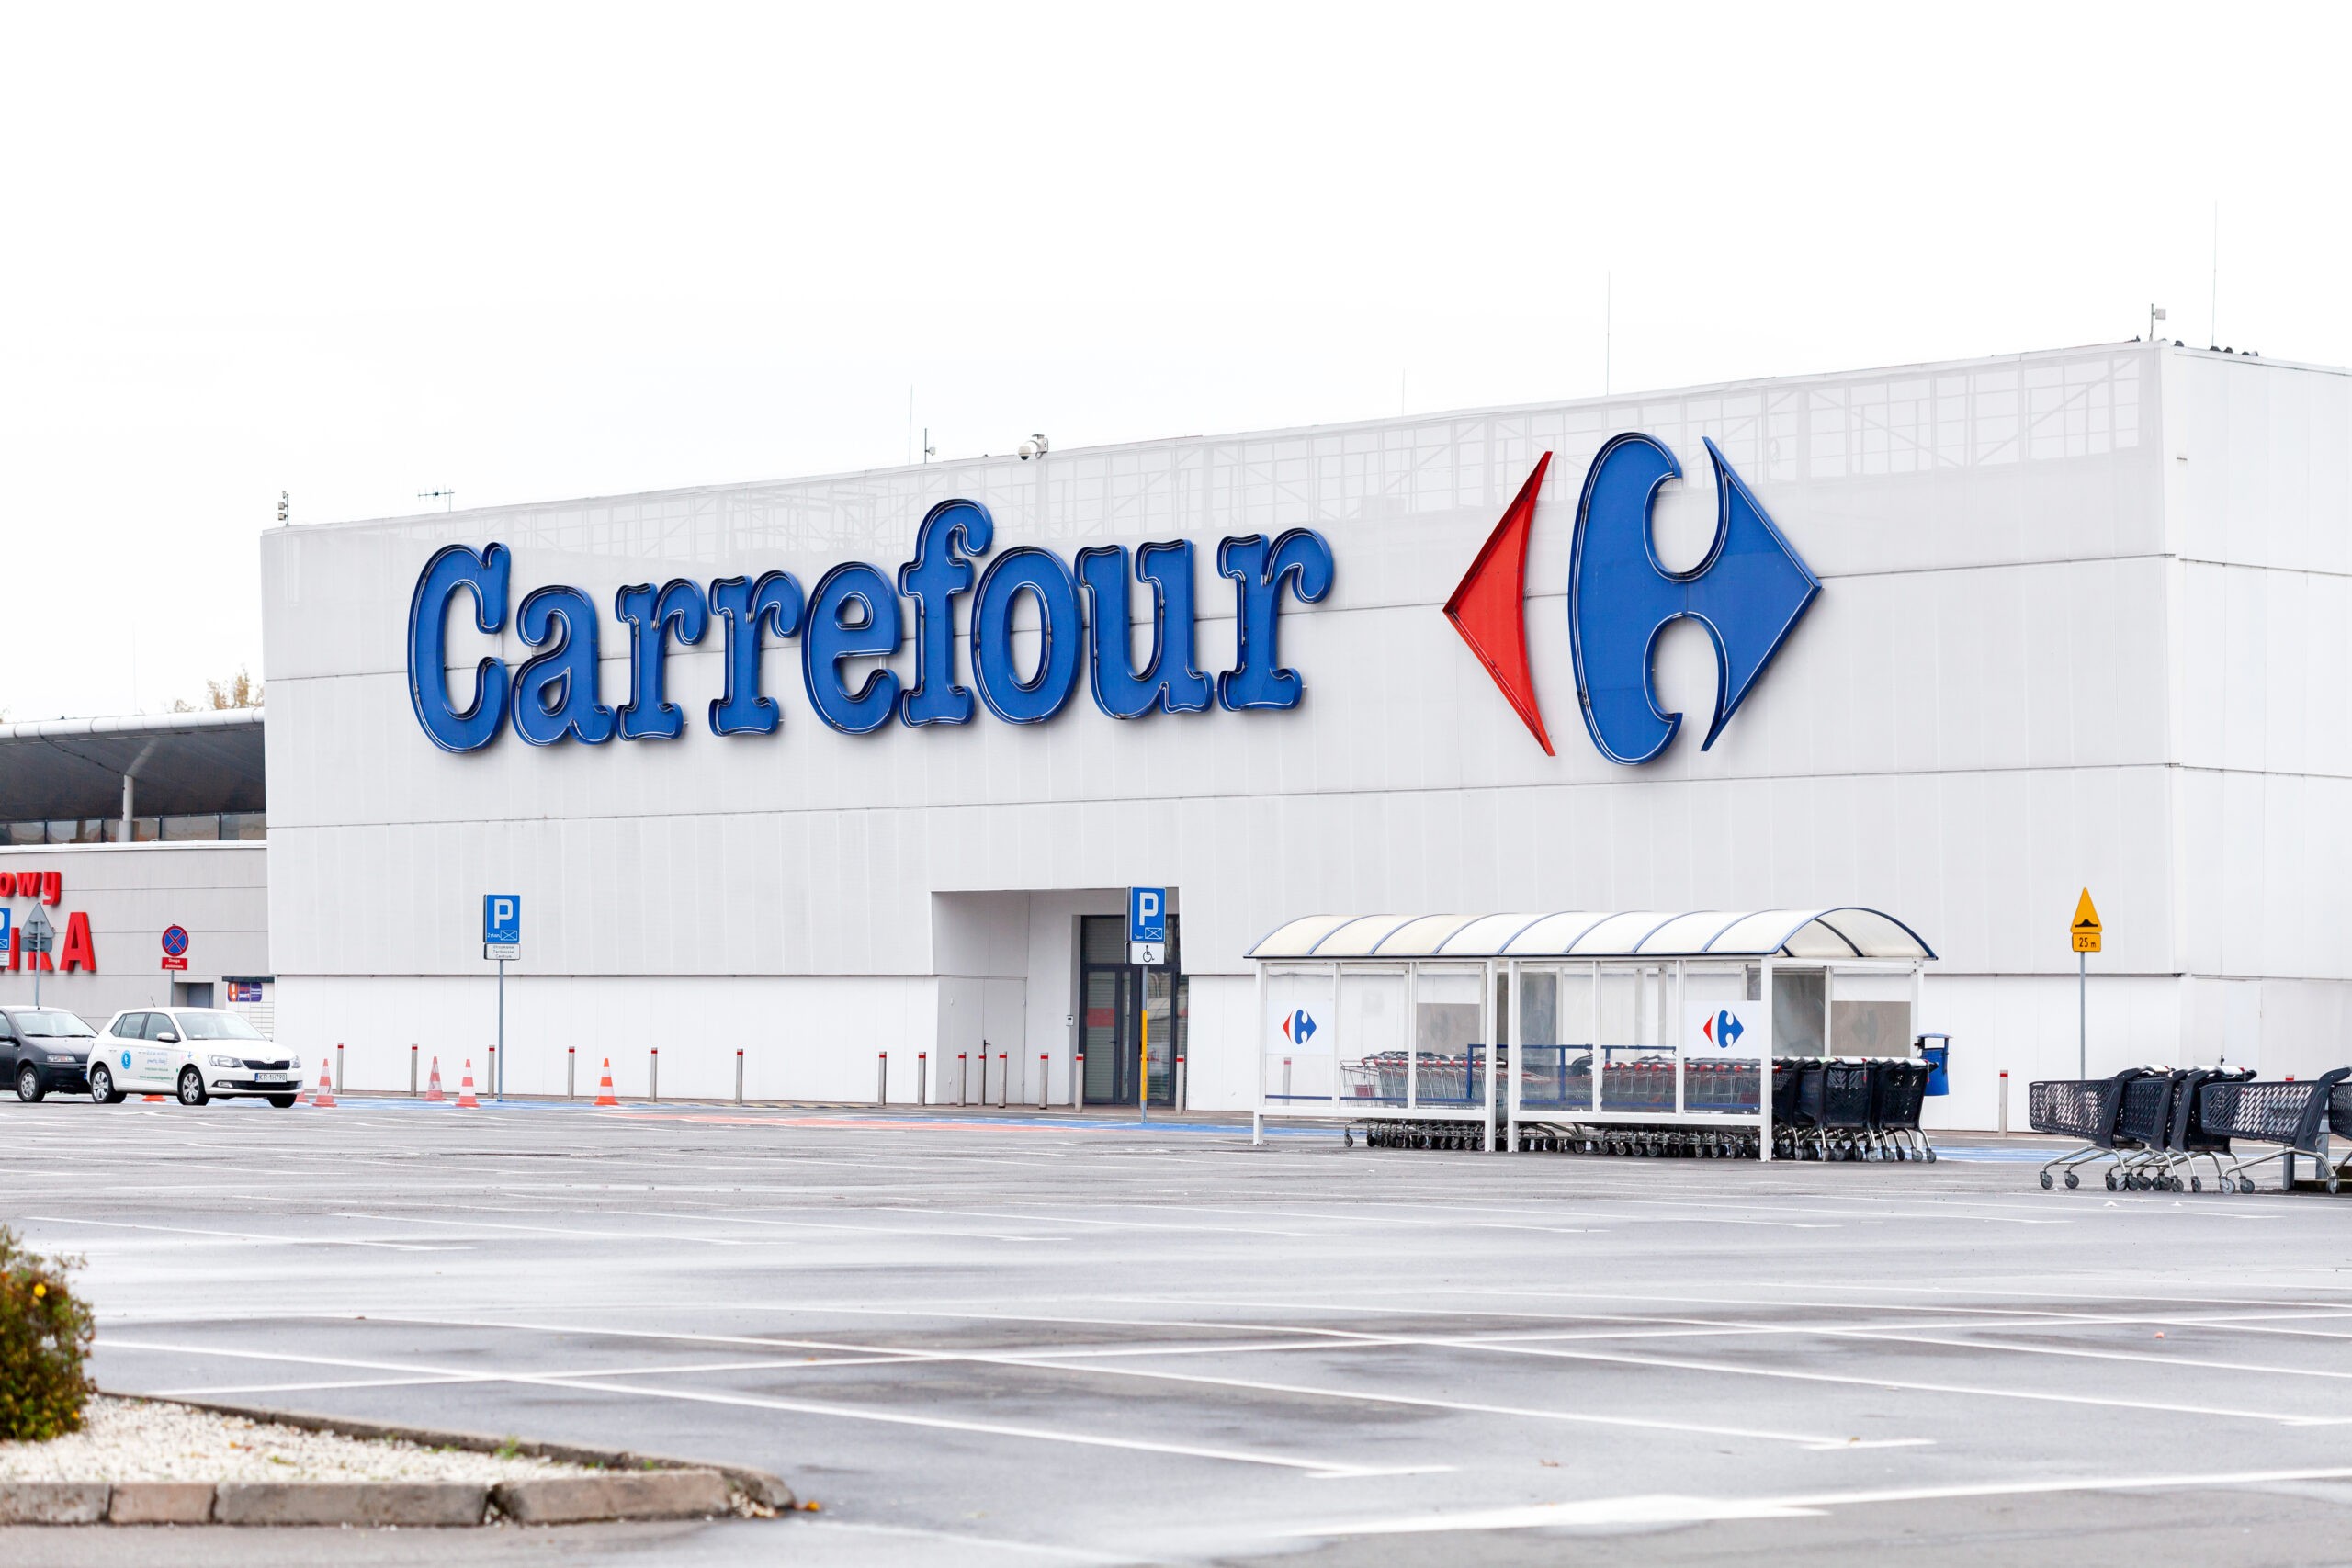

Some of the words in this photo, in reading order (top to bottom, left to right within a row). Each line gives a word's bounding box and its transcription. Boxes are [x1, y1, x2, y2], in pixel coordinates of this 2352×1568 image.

[407, 499, 1333, 753] Carrefour
[494, 899, 514, 929] P
[1139, 892, 1159, 926] P
[2079, 937, 2088, 947] 25
